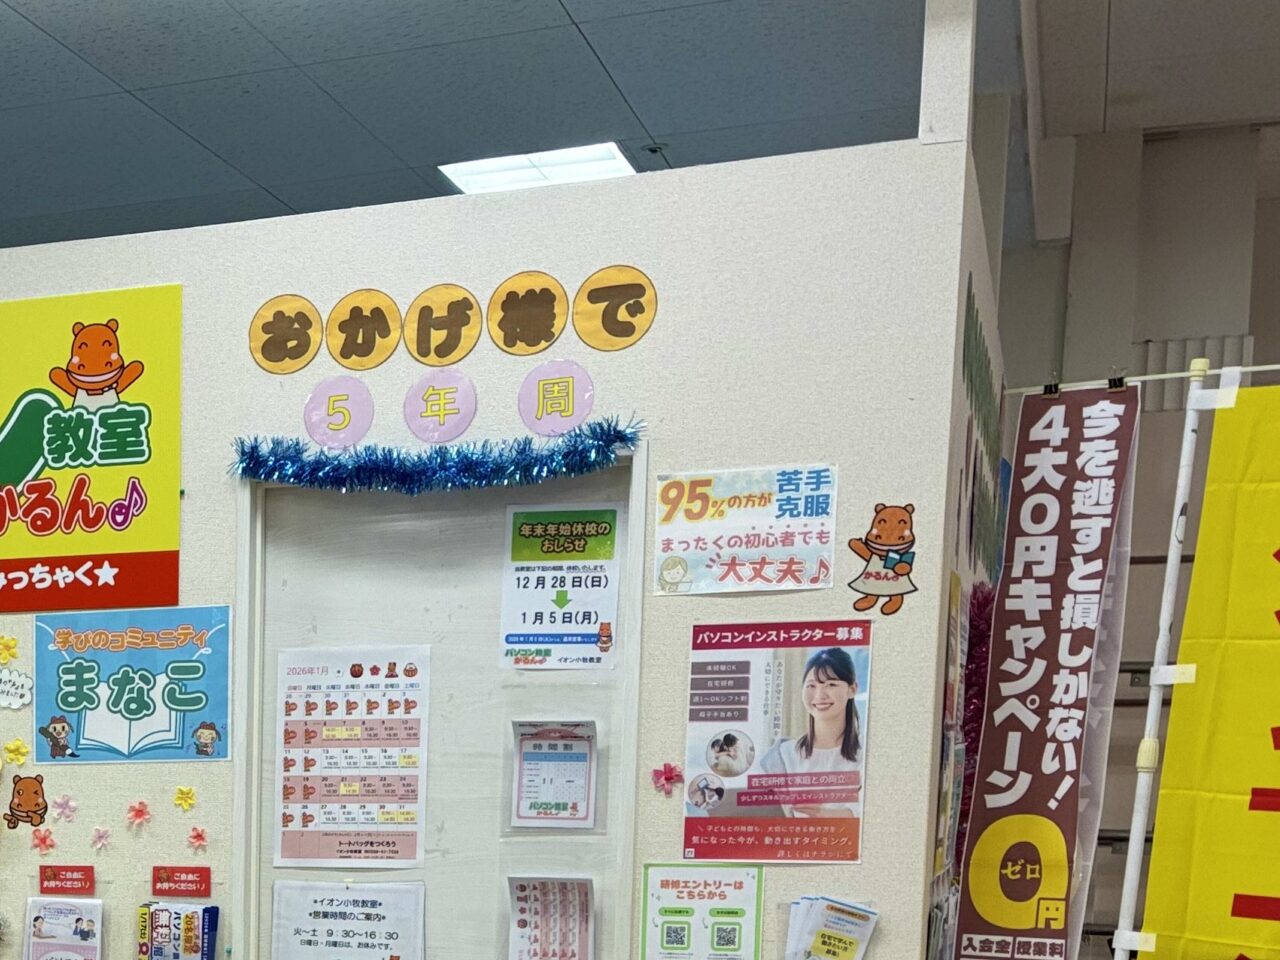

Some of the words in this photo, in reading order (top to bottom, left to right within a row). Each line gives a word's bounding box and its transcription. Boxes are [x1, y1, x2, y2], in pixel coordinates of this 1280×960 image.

[260, 281, 648, 363] おかげ様で
[326, 376, 575, 431] 5年周
[43, 404, 151, 468] 教室
[776, 467, 832, 495] 苦手
[660, 478, 773, 524] 95%の方が
[775, 493, 832, 520] 克服
[519, 522, 610, 537] 年末年始休校の
[661, 529, 832, 553] まったくの初心者でも
[540, 538, 587, 552] おしらせ
[717, 554, 806, 586] 大丈夫
[984, 404, 1070, 808] 4大0円キャンペーン
[1040, 400, 1126, 809] 今を逃すと損しかない!
[54, 627, 209, 652] 学びのコミュニティ
[697, 627, 864, 644] パソコンインストラクター募集
[56, 658, 209, 720] まなこ
[1000, 859, 1041, 880] ゼロ
[962, 937, 1012, 955] 入会金
